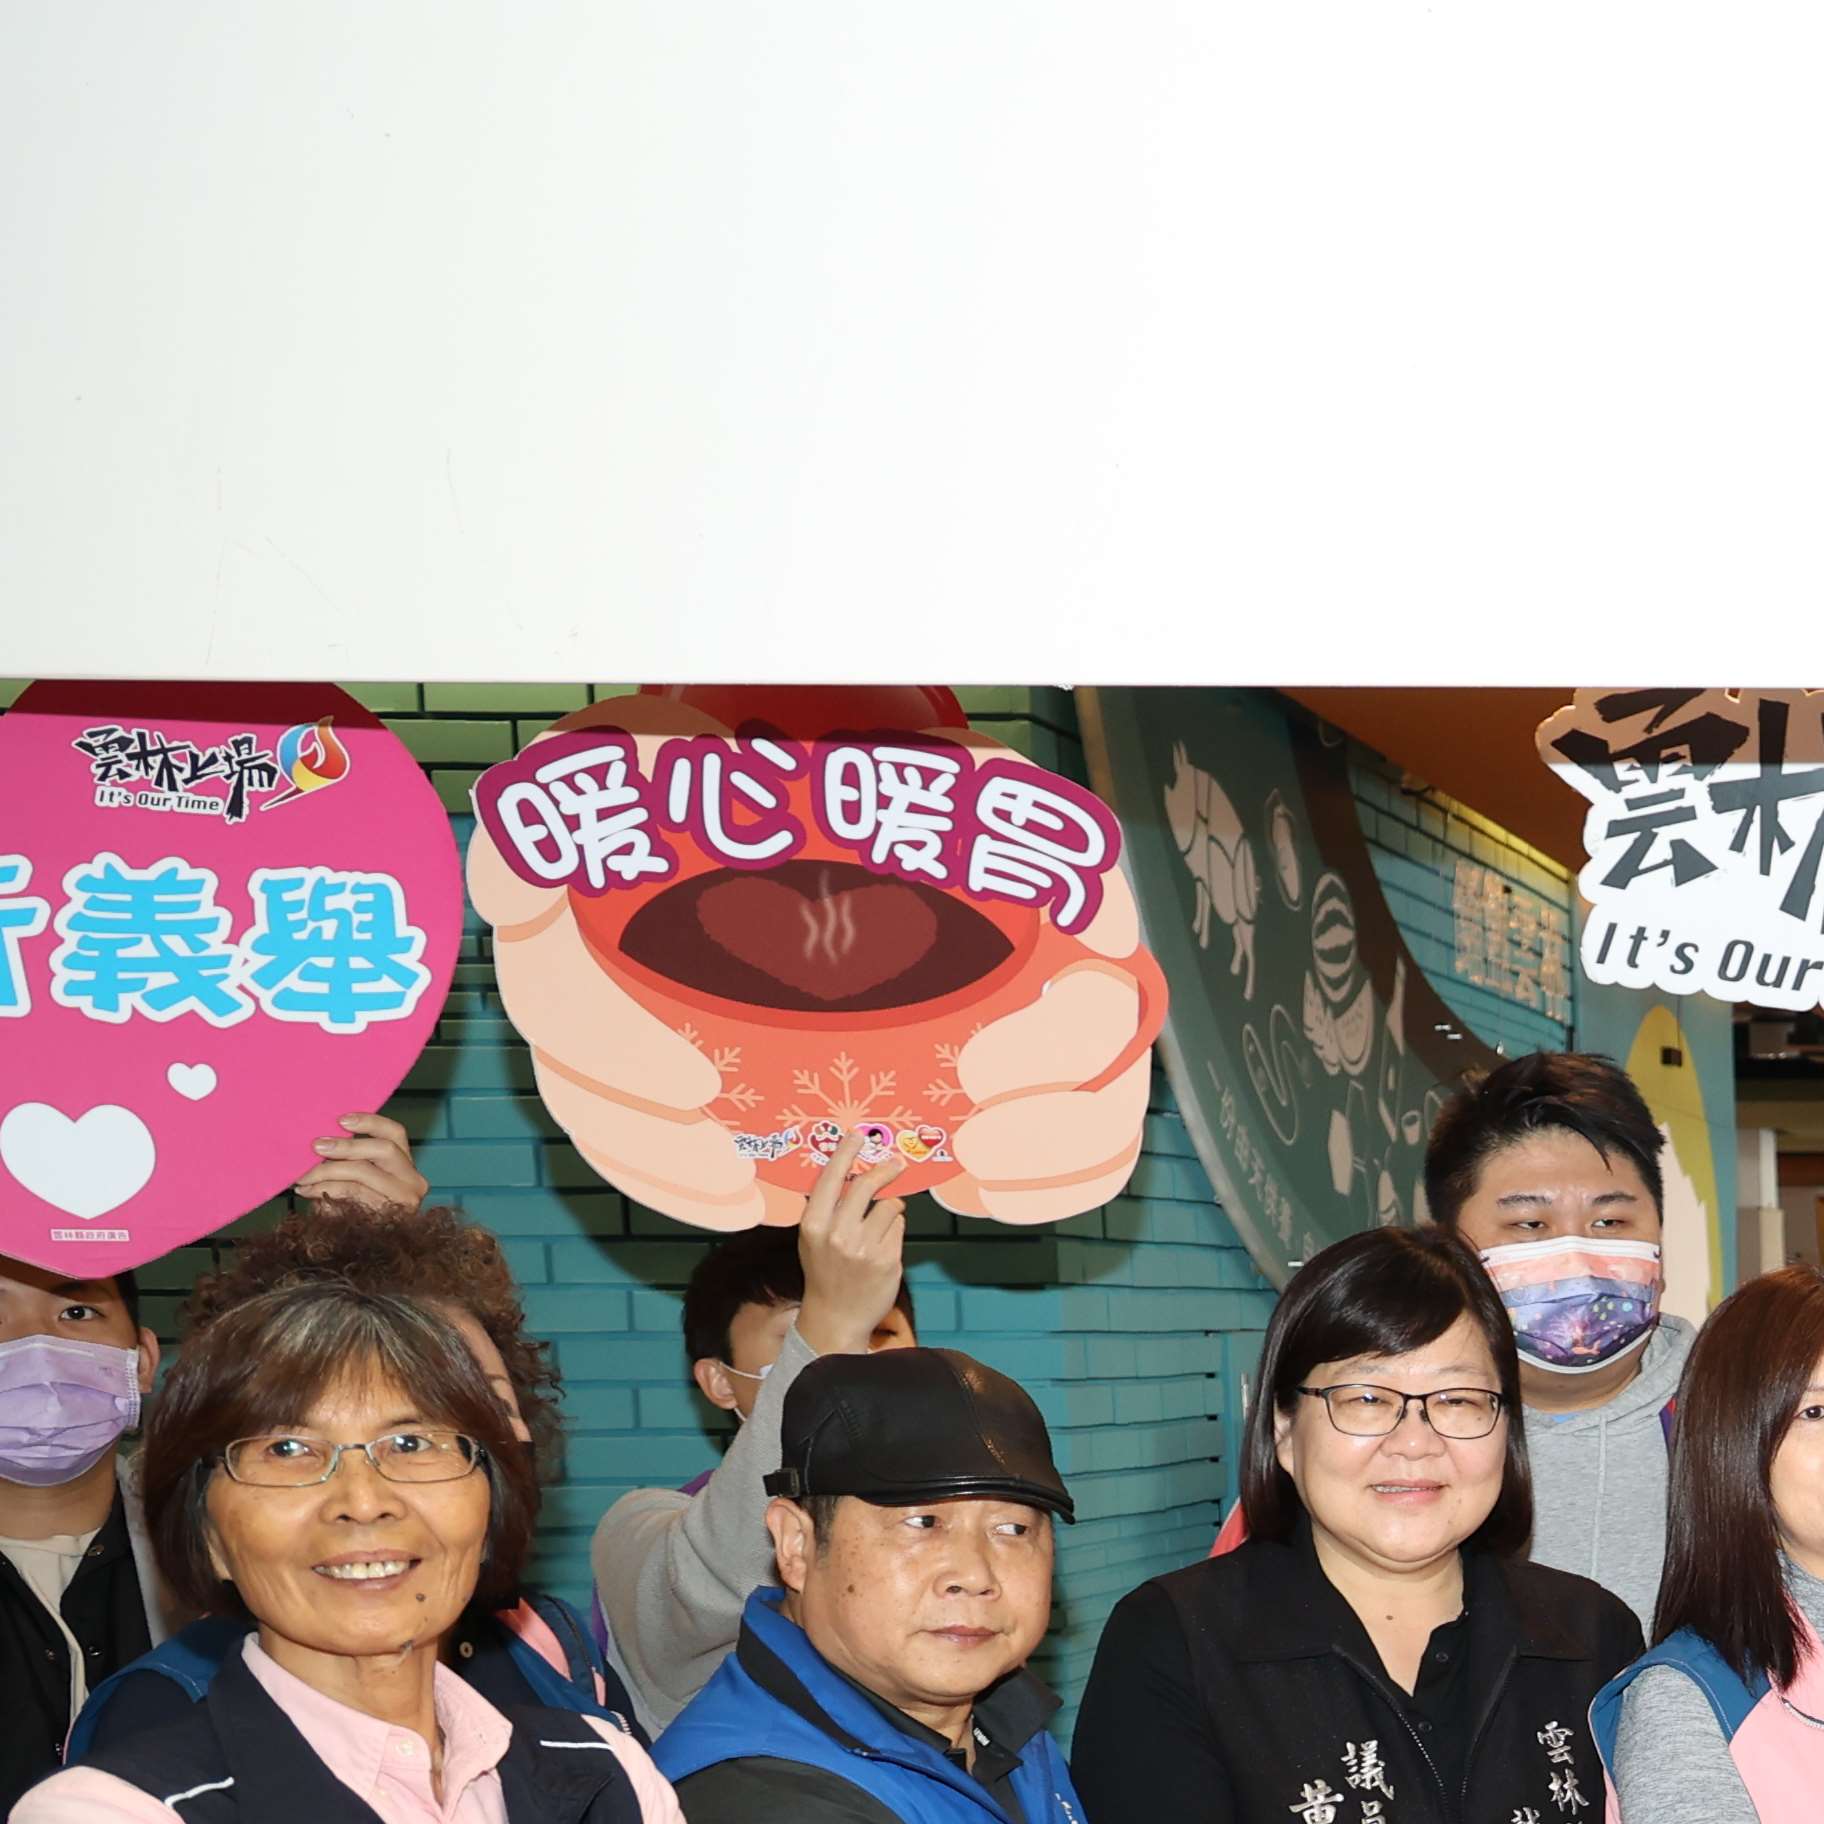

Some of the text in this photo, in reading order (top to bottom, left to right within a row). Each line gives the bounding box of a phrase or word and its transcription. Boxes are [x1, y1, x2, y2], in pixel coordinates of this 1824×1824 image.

[98, 791, 220, 811] It's Our Time
[498, 738, 1108, 926] 暖心暖胃
[1594, 919, 1696, 976] It's
[1716, 938, 1824, 993] Our
